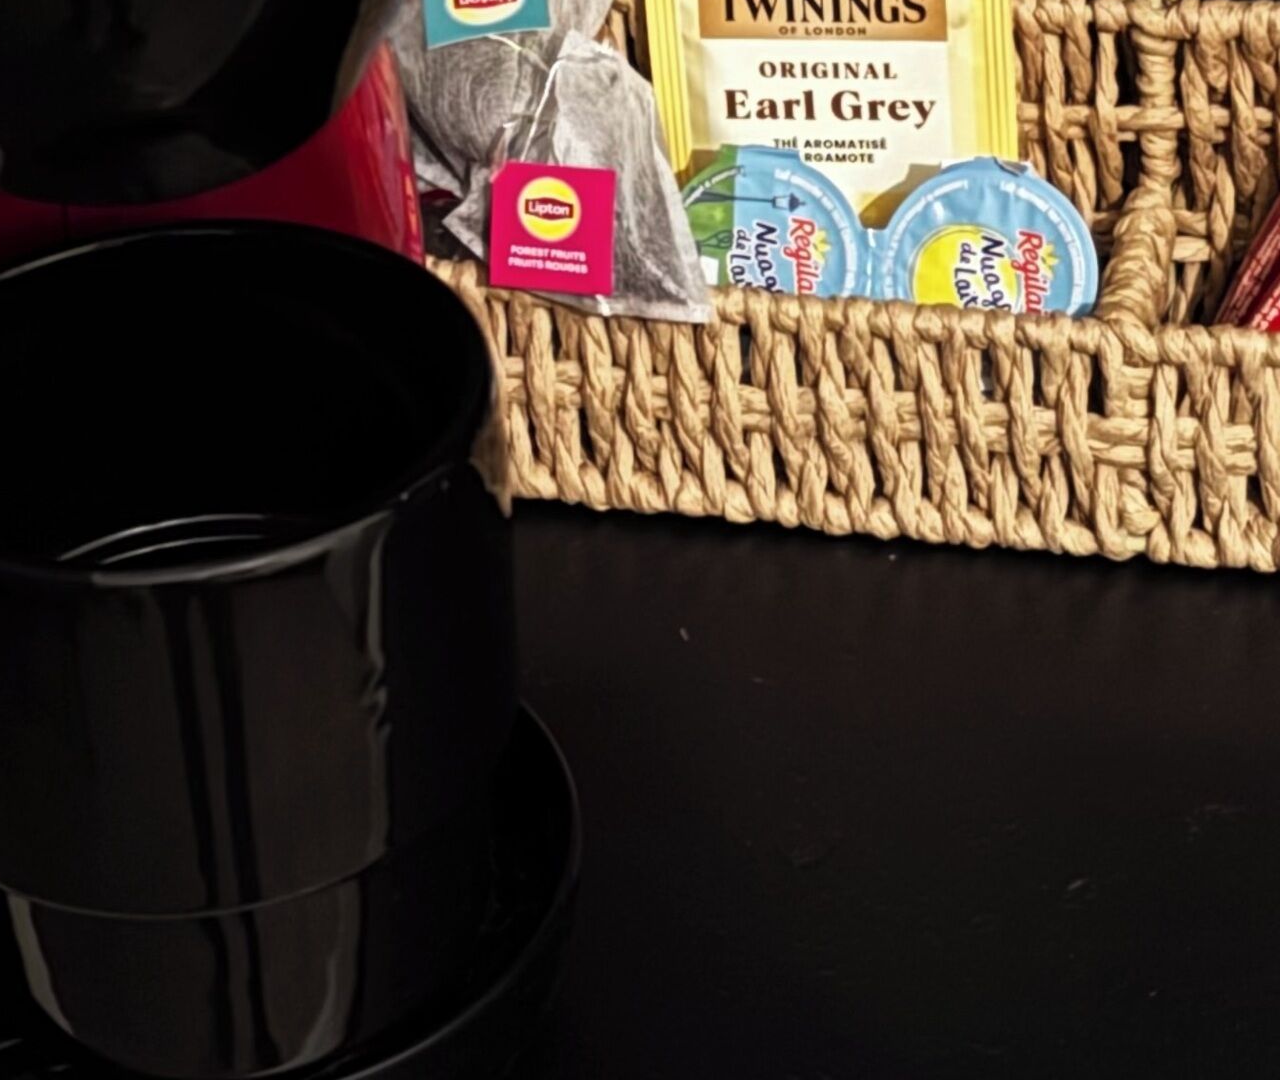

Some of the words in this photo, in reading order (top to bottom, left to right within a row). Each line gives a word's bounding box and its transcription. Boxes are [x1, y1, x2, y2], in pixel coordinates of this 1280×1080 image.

[778, 26, 797, 36] OF
[804, 26, 867, 36] LONDON
[758, 61, 898, 80] ORIGINAL
[724, 89, 817, 121] Earl
[830, 89, 937, 130] Grey
[803, 136, 888, 150] AROMATISÉ
[528, 200, 570, 217] Lipton
[736, 229, 751, 250] de
[960, 242, 977, 263] de
